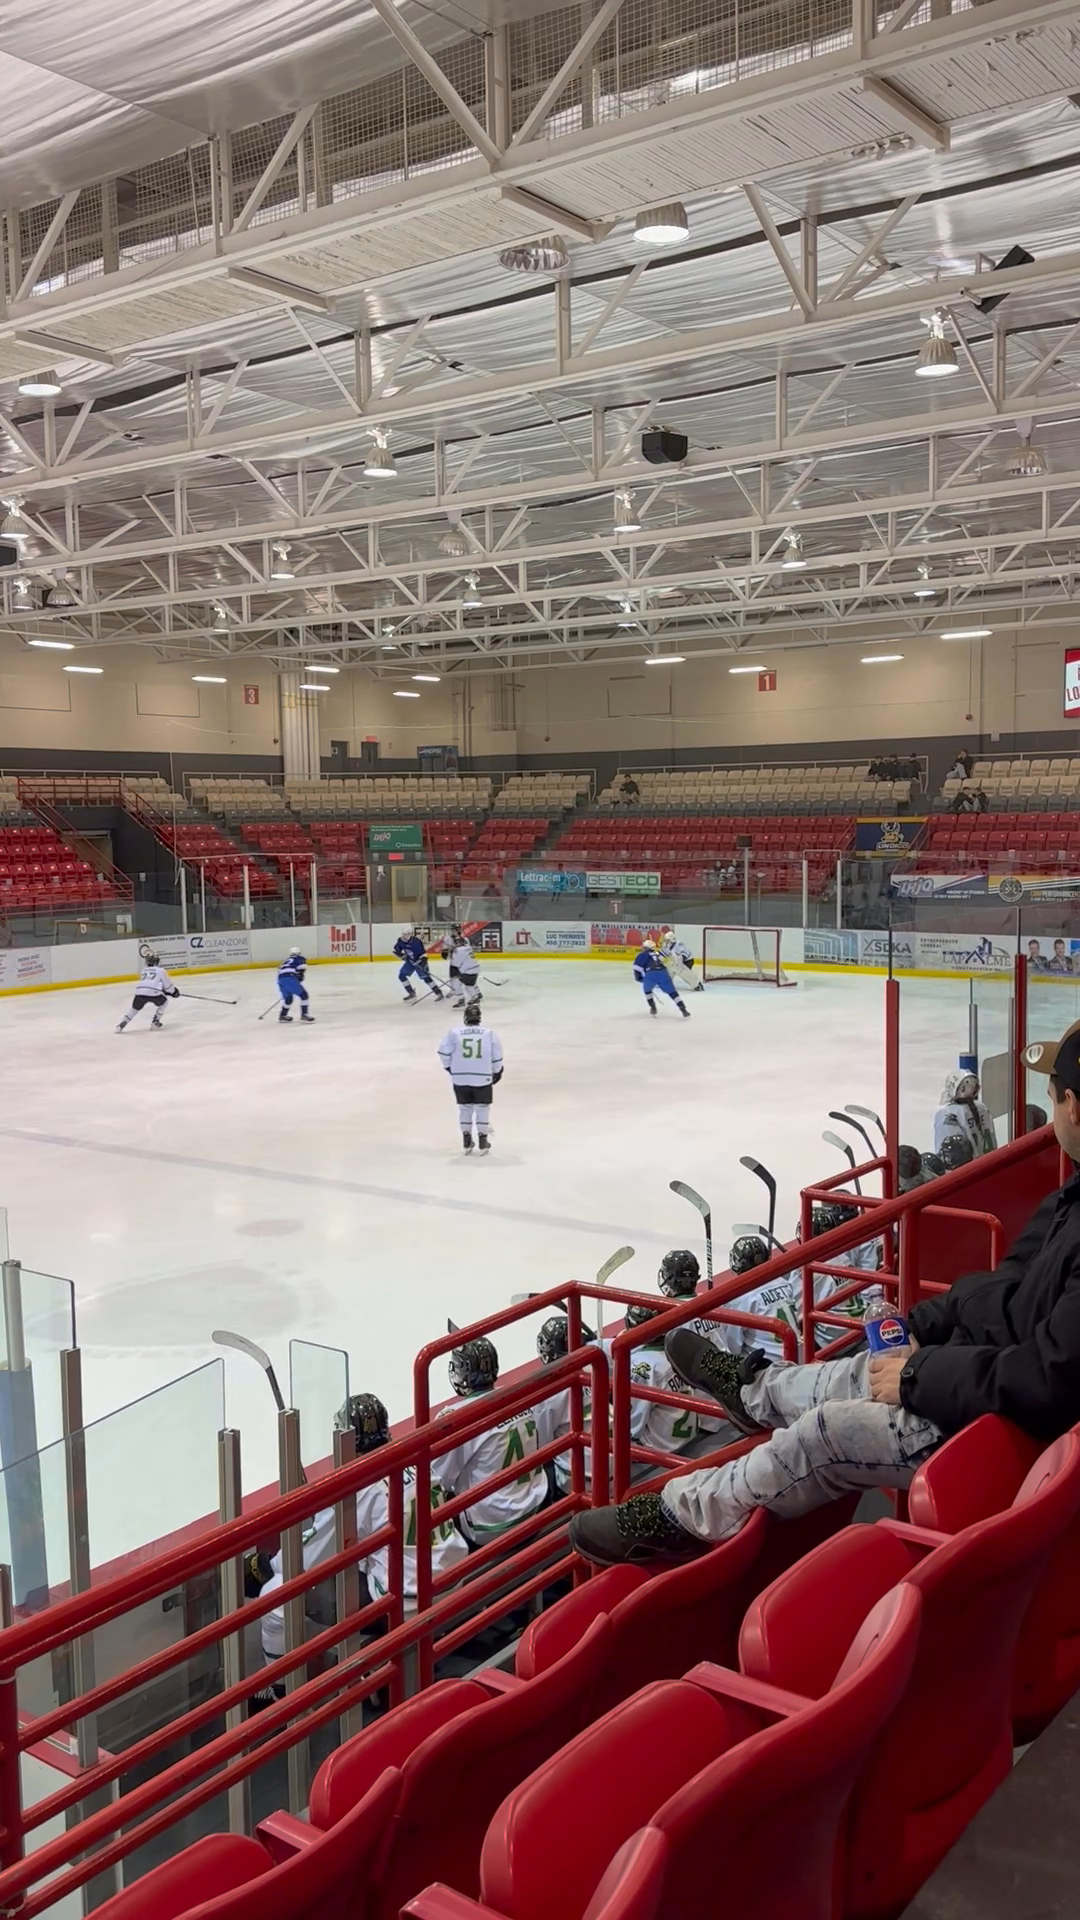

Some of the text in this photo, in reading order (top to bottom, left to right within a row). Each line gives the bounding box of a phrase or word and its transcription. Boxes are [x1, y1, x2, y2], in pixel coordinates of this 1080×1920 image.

[763, 674, 770, 691] 1
[248, 688, 256, 704] 3
[1066, 685, 1080, 702] LO
[587, 874, 659, 886] GESTECO
[204, 938, 249, 948] CLEANZONE
[516, 931, 531, 945] LT
[331, 942, 357, 952] M105
[462, 1038, 482, 1059] 51
